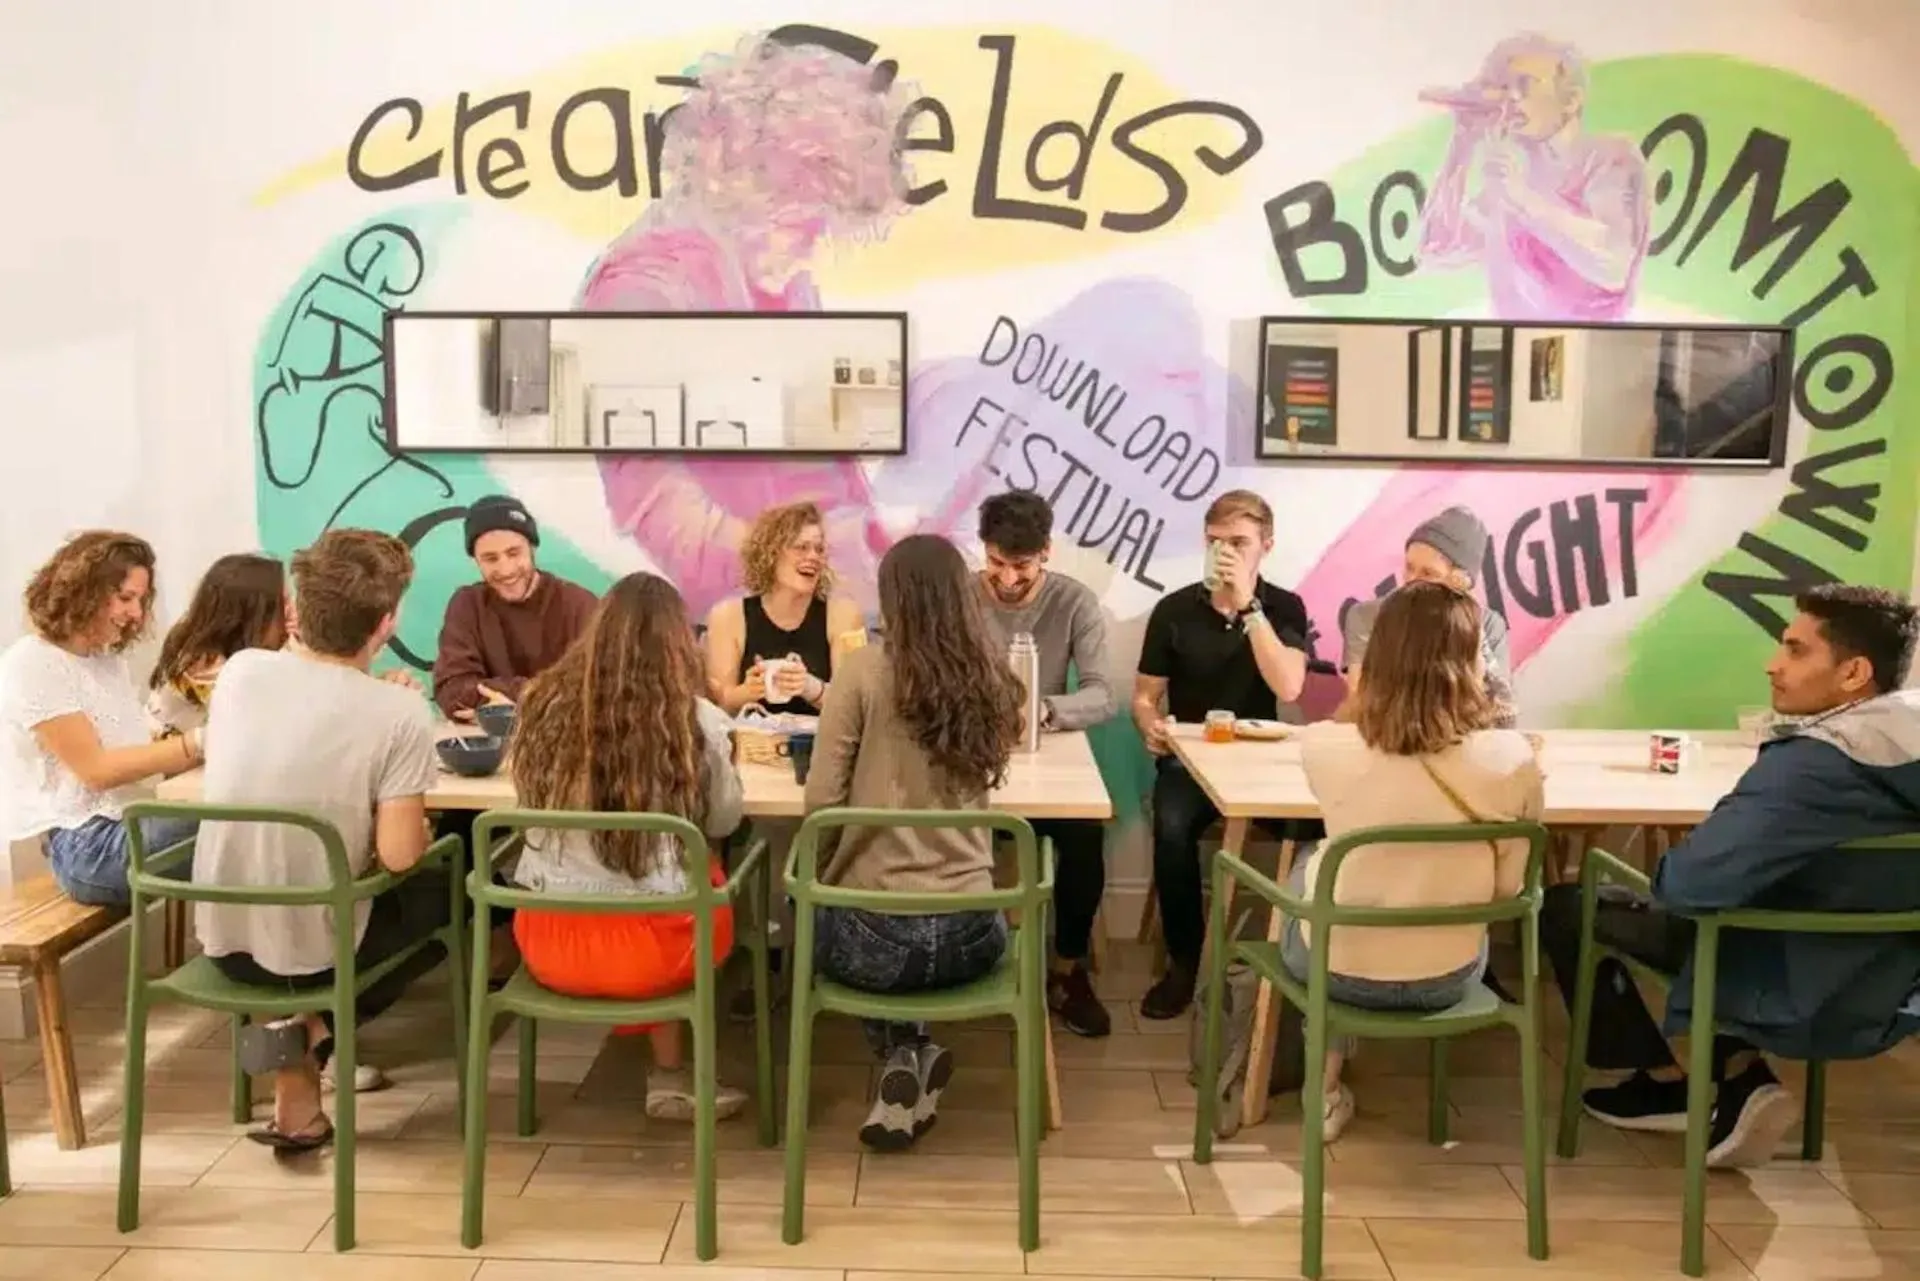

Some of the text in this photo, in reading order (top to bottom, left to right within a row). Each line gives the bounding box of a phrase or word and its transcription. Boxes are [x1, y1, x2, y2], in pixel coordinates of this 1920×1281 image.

[955, 396, 1165, 592] FESTIVAL
[979, 315, 1220, 501] DOWNLOAD
[1481, 488, 1648, 632] IGHT
